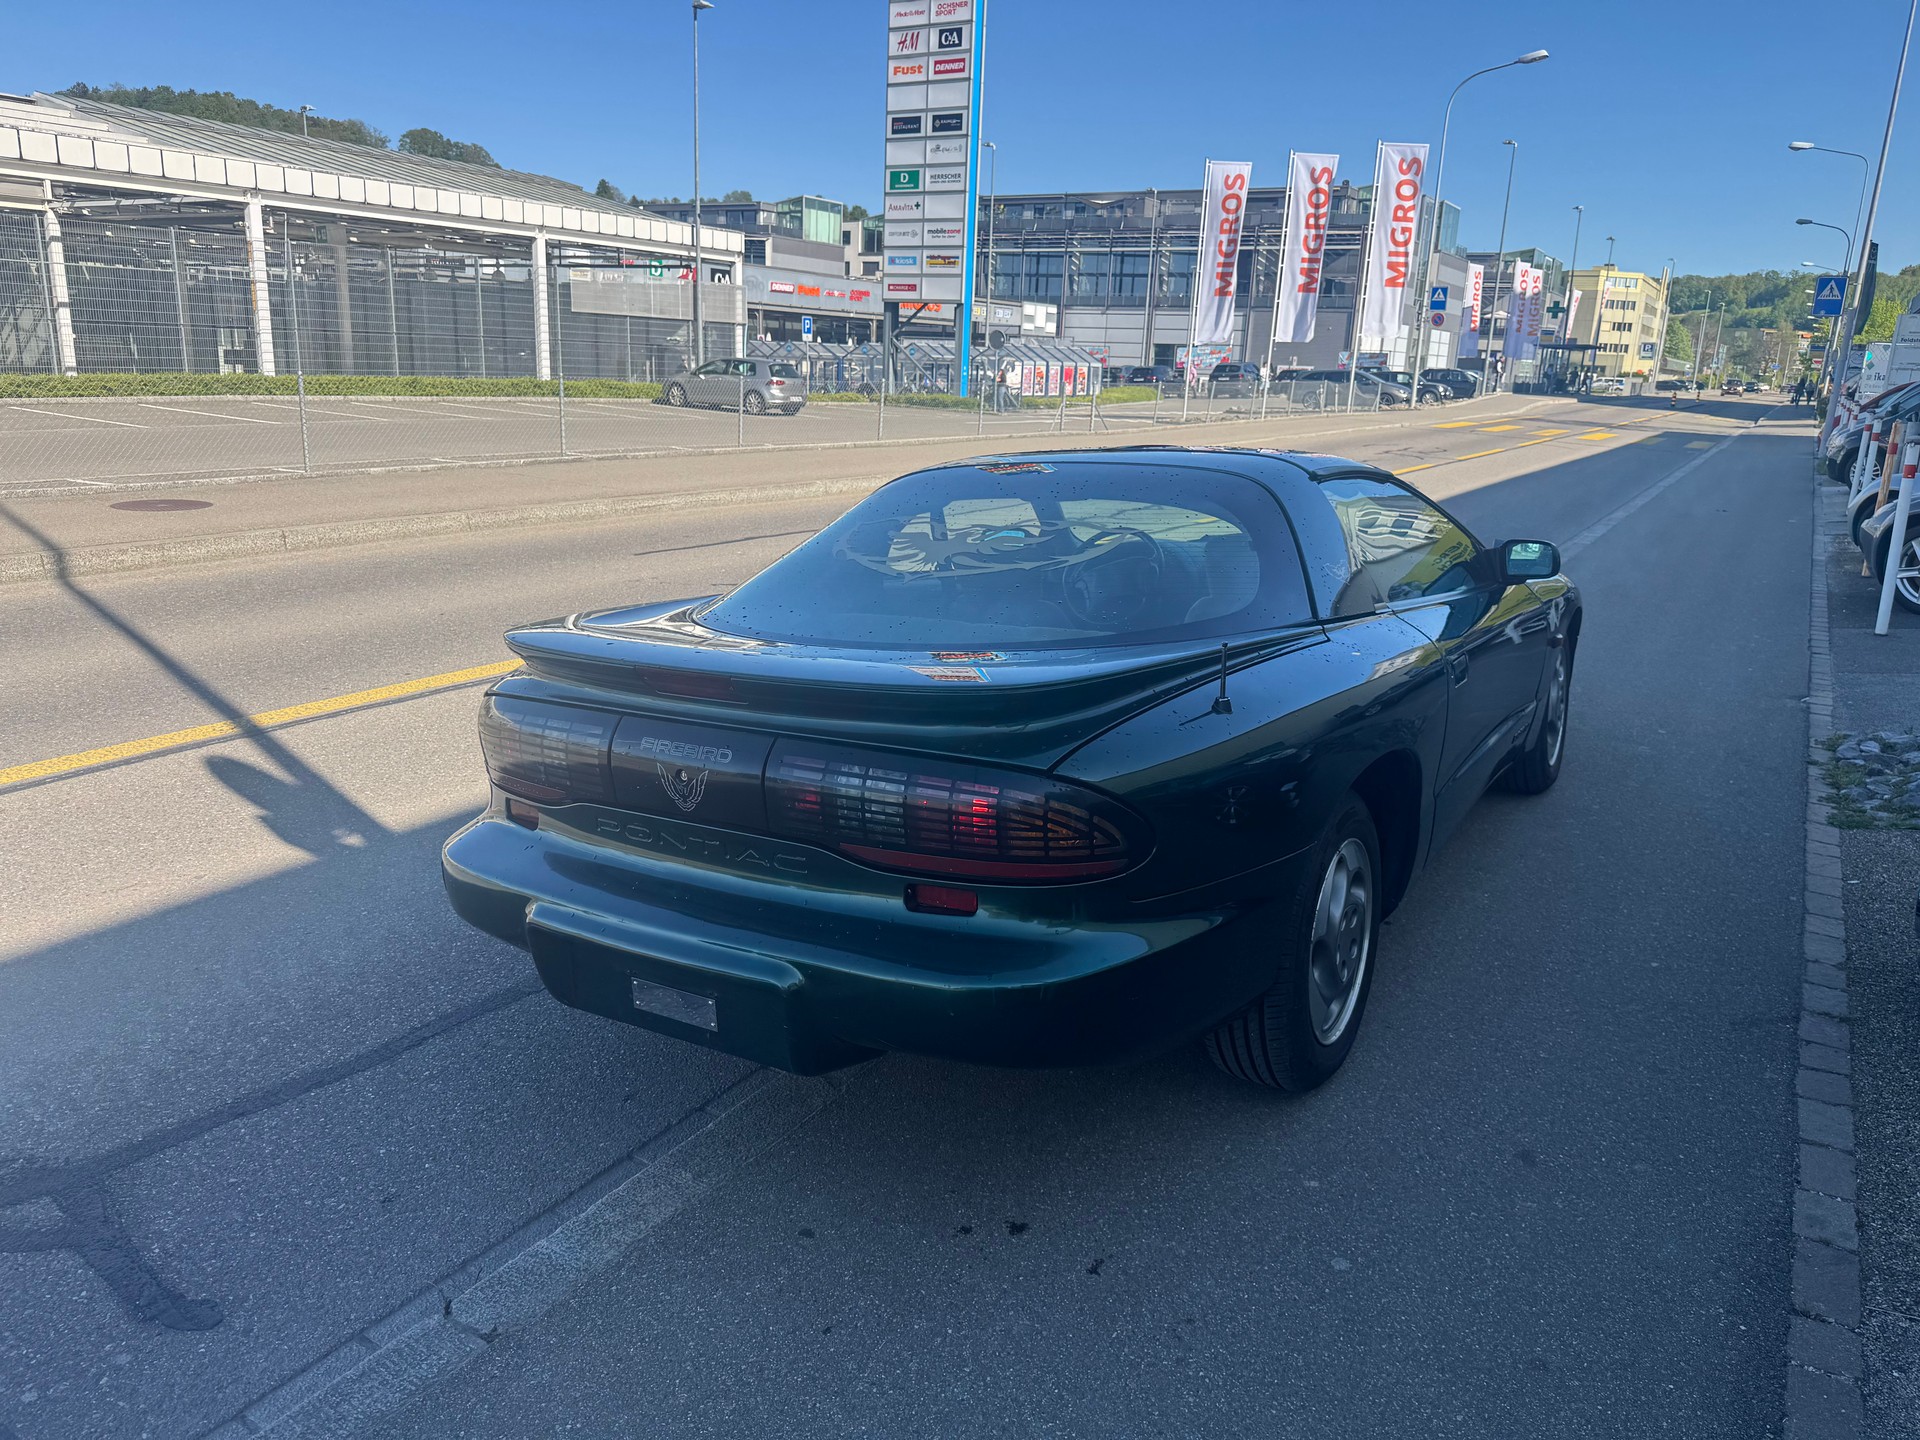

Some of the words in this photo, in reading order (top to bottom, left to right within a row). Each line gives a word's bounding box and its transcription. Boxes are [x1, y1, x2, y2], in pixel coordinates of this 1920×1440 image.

[935, 9, 957, 17] SPORT
[937, 1, 968, 10] OCHSNER
[897, 31, 920, 52] H&M
[935, 61, 965, 71] DENNER
[900, 172, 909, 183] D
[1297, 166, 1333, 293] MIGROS
[1384, 156, 1422, 288] MIGROS
[1214, 173, 1246, 297] MIGROS
[895, 257, 914, 265] kiosk
[771, 283, 794, 292] DENNER
[1470, 271, 1482, 333] MIGROS
[1516, 268, 1529, 334] MIGROS
[1527, 275, 1541, 337] MIGROS
[804, 320, 810, 332] P
[640, 736, 733, 764] FIREBIRD
[597, 818, 808, 874] PONTIAC
